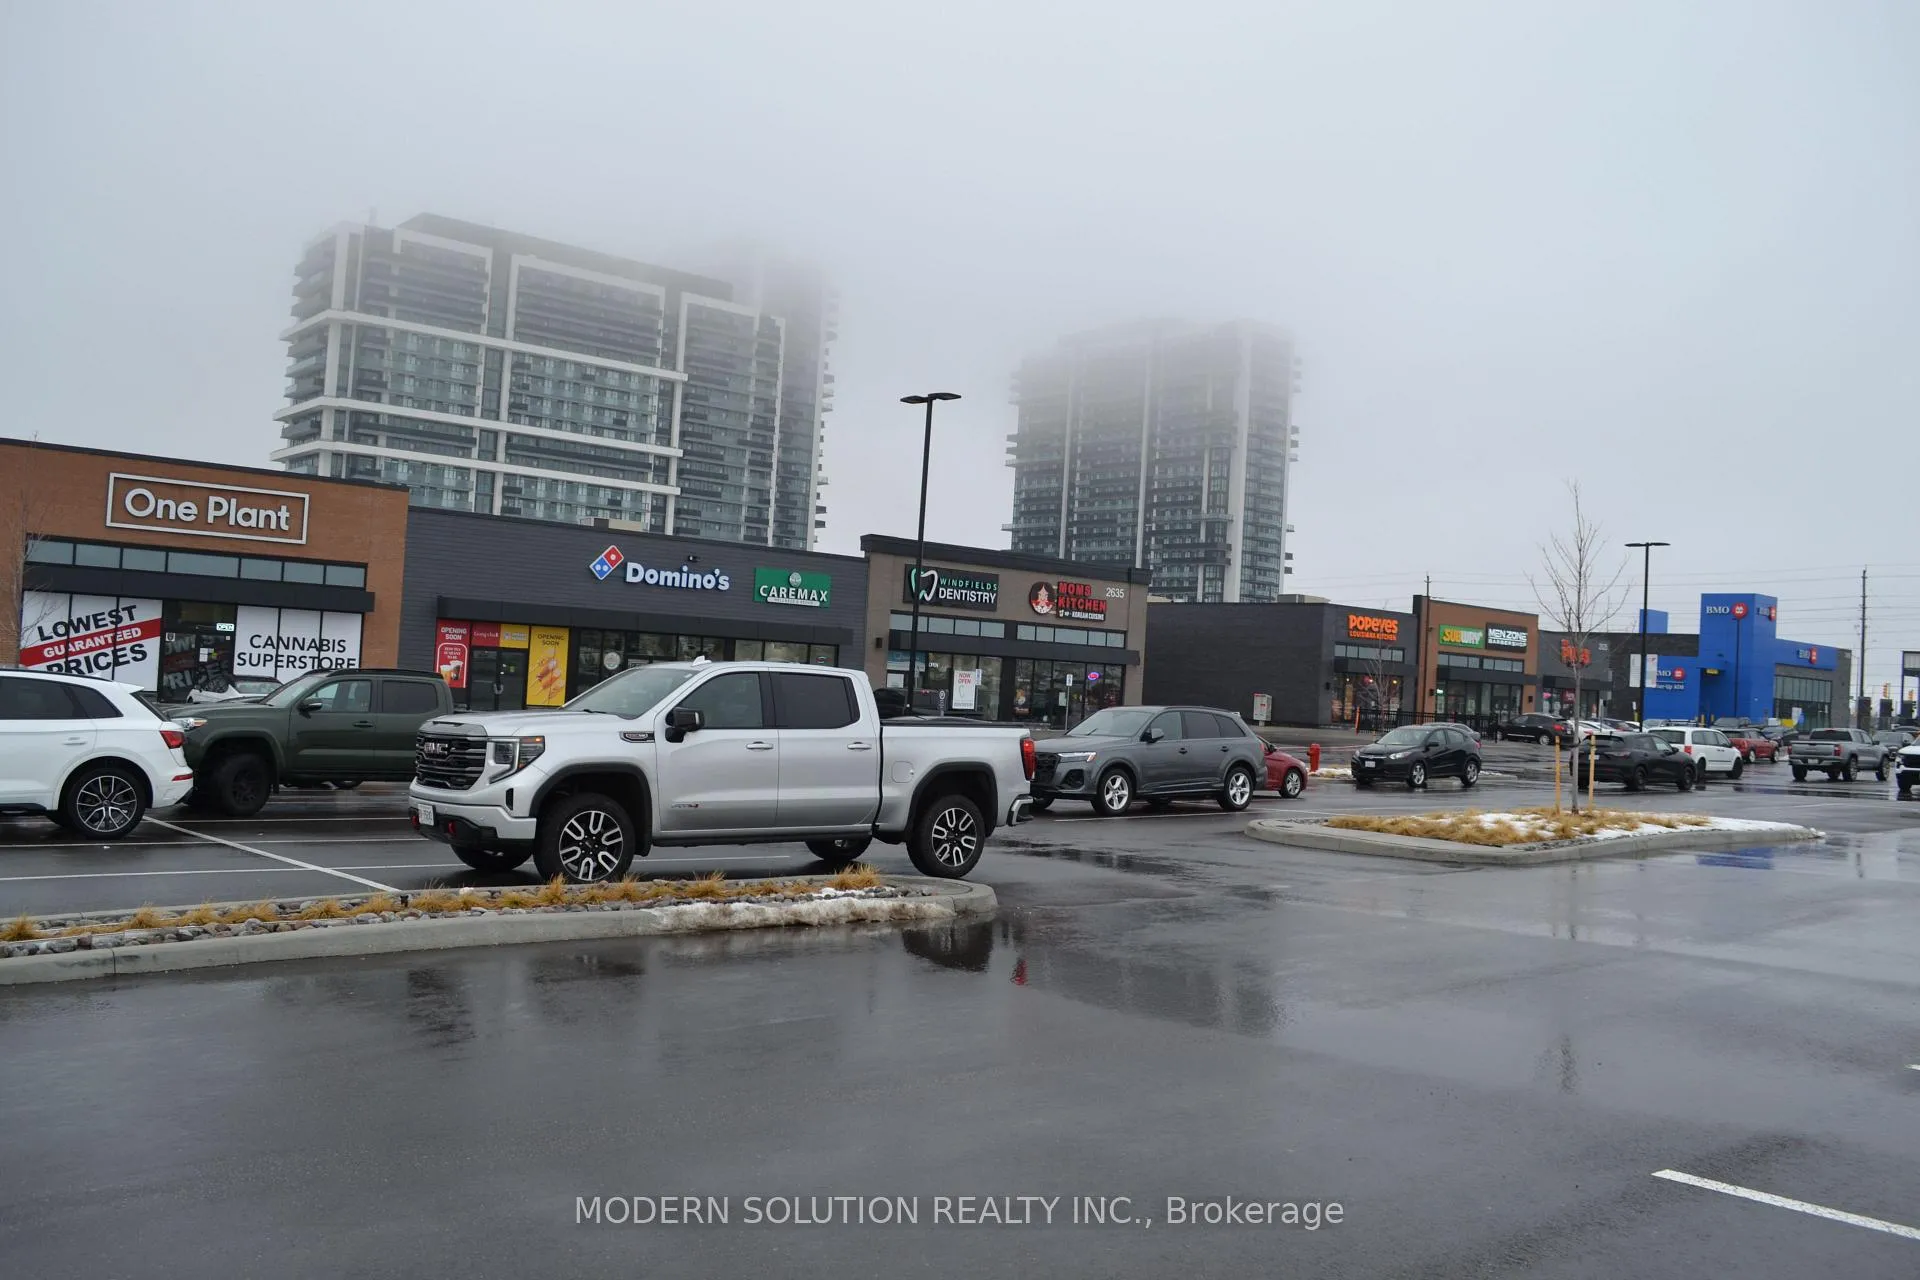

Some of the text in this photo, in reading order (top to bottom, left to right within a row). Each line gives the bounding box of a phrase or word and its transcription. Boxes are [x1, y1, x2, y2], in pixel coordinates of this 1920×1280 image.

[125, 488, 290, 532] One Plant
[626, 562, 730, 591] Domino's
[939, 577, 998, 591] WINDFIELDS
[760, 585, 828, 602] CAREMAX
[939, 587, 996, 604] DENTISTRY
[1058, 582, 1092, 597] MOMS
[1106, 587, 1125, 598] 2635
[1057, 596, 1107, 612] KITCHEN
[1706, 606, 1730, 614] BMO
[37, 605, 137, 642] LOWEST
[43, 627, 142, 658] GUARANTEED
[1442, 628, 1481, 645] SUBWAY
[1488, 628, 1527, 641] MEN ZONE
[249, 634, 347, 654] CANNABIS
[46, 643, 148, 675] PRICES
[236, 652, 357, 670] SUPERSTORE
